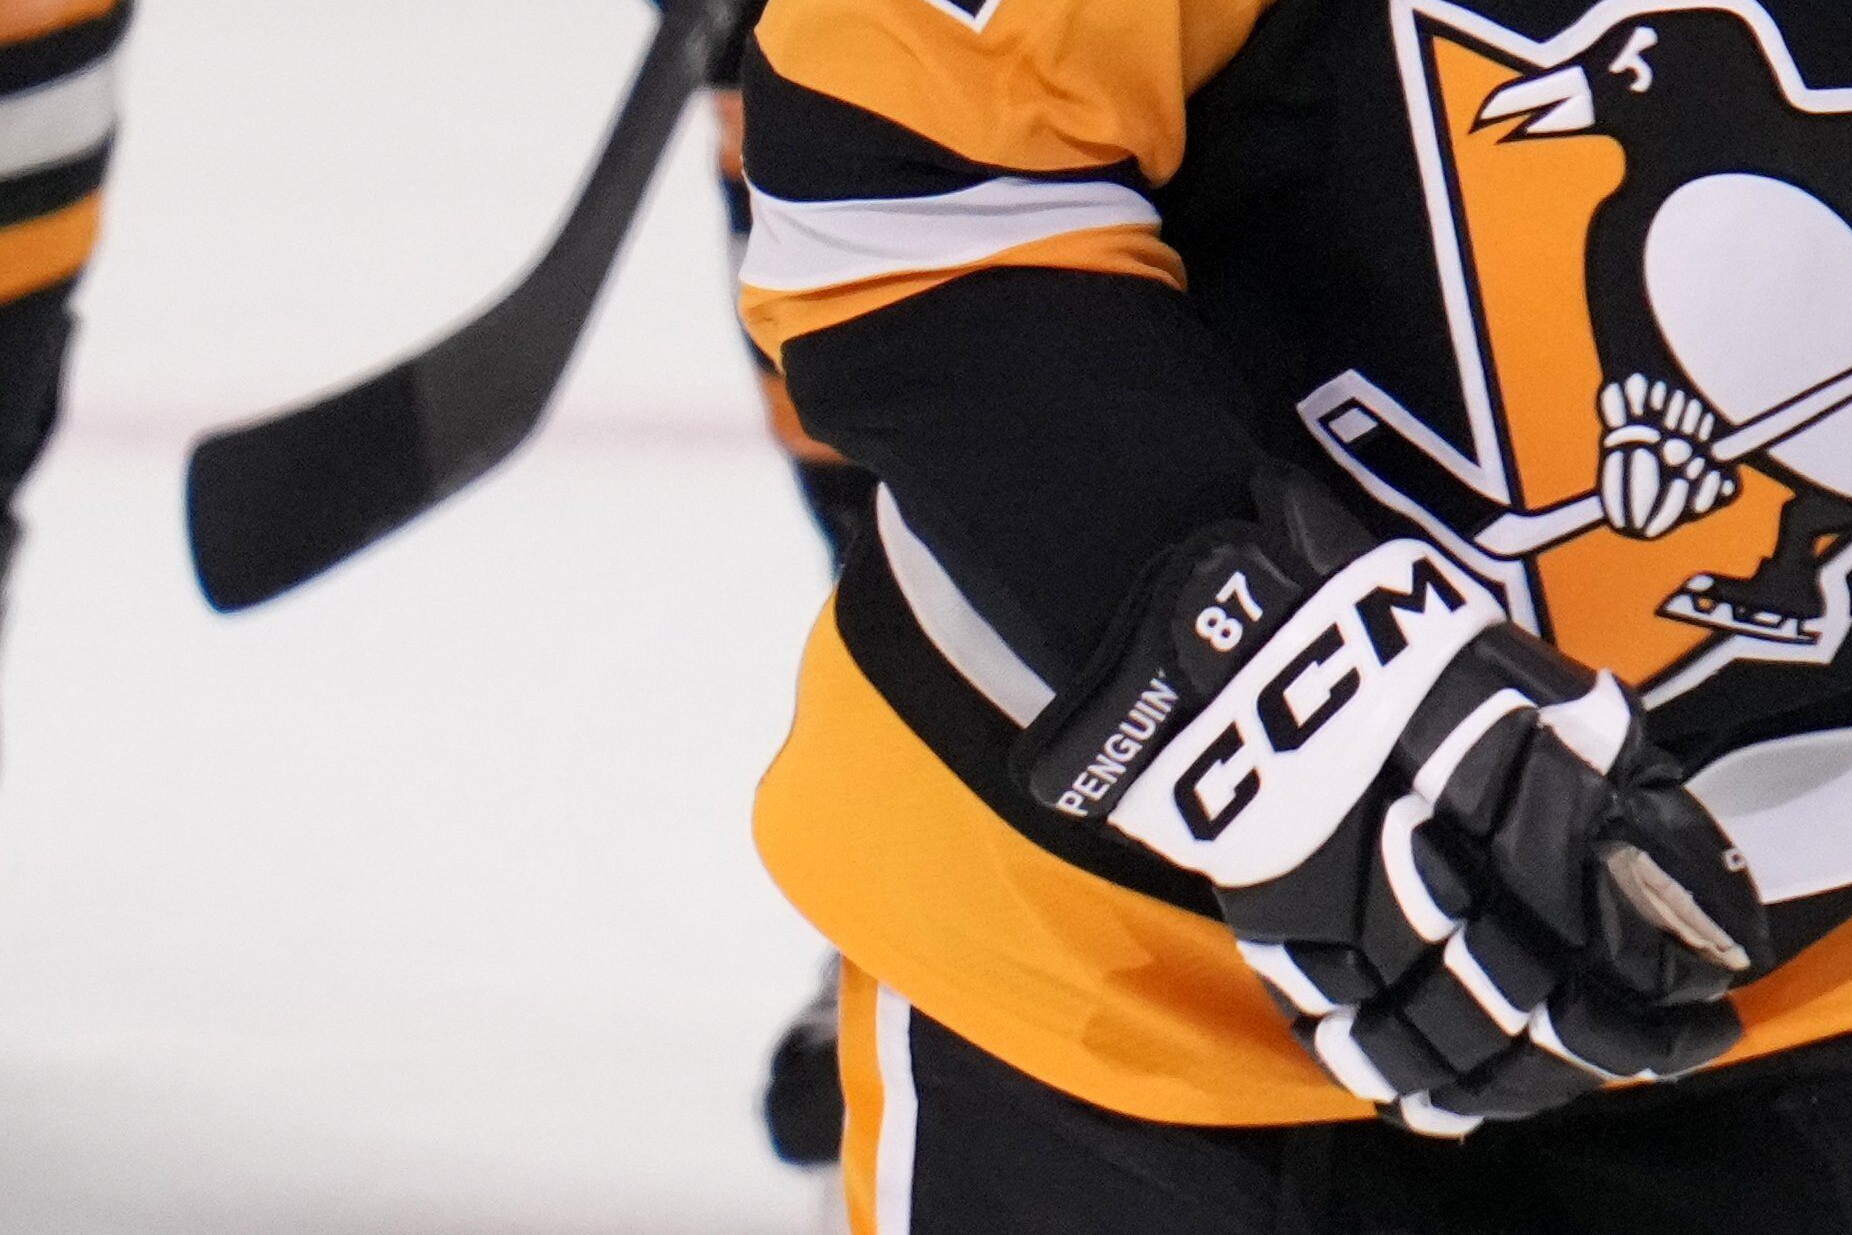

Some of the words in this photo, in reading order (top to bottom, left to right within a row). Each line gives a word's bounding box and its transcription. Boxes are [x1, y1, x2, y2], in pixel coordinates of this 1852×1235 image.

[1195, 571, 1264, 652] 87
[1055, 667, 1178, 817] PENGUIN
[1173, 556, 1467, 842] CCM
